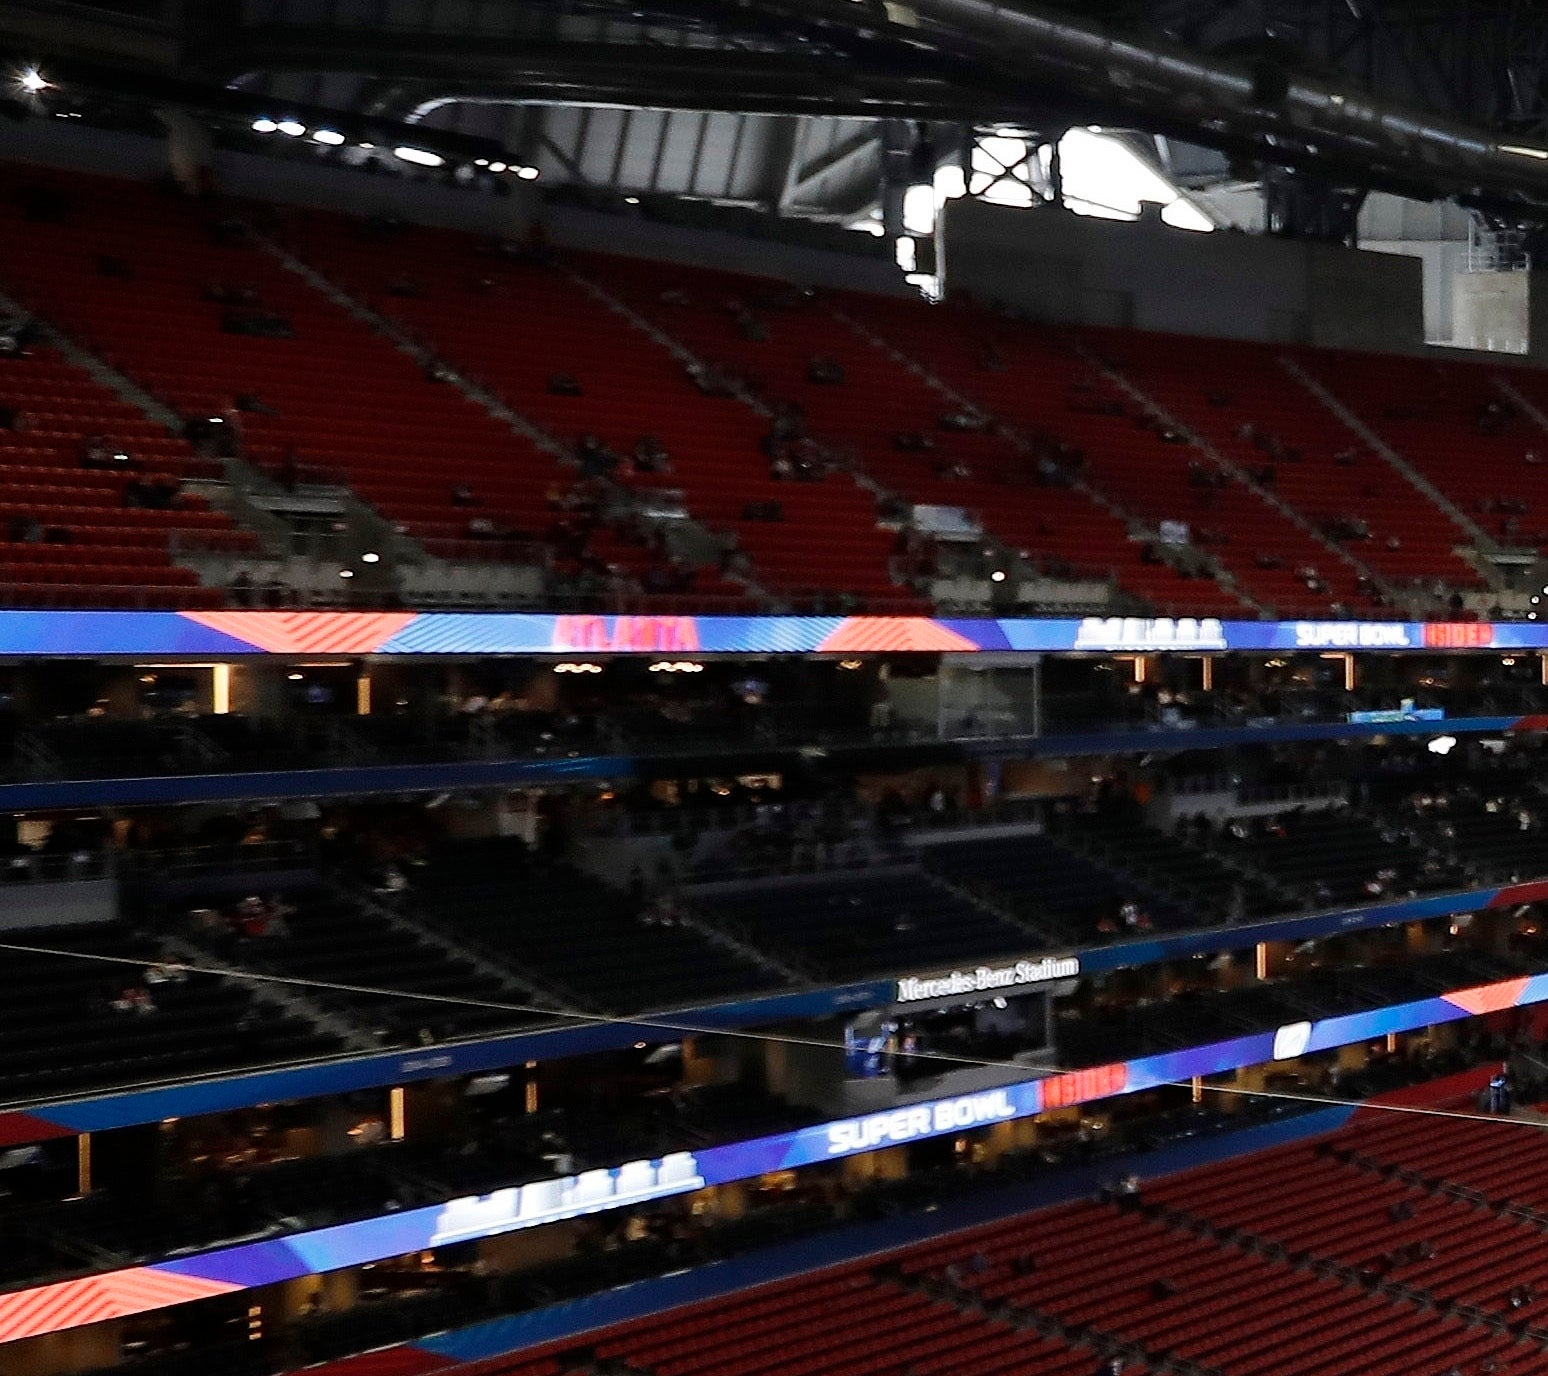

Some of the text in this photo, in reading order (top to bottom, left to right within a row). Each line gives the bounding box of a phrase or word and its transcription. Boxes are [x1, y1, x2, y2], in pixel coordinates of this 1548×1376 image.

[897, 956, 1080, 1003] Mercedes-Benz Stadium
[827, 1108, 932, 1155] SUPER
[933, 1091, 1016, 1132] BOWL
